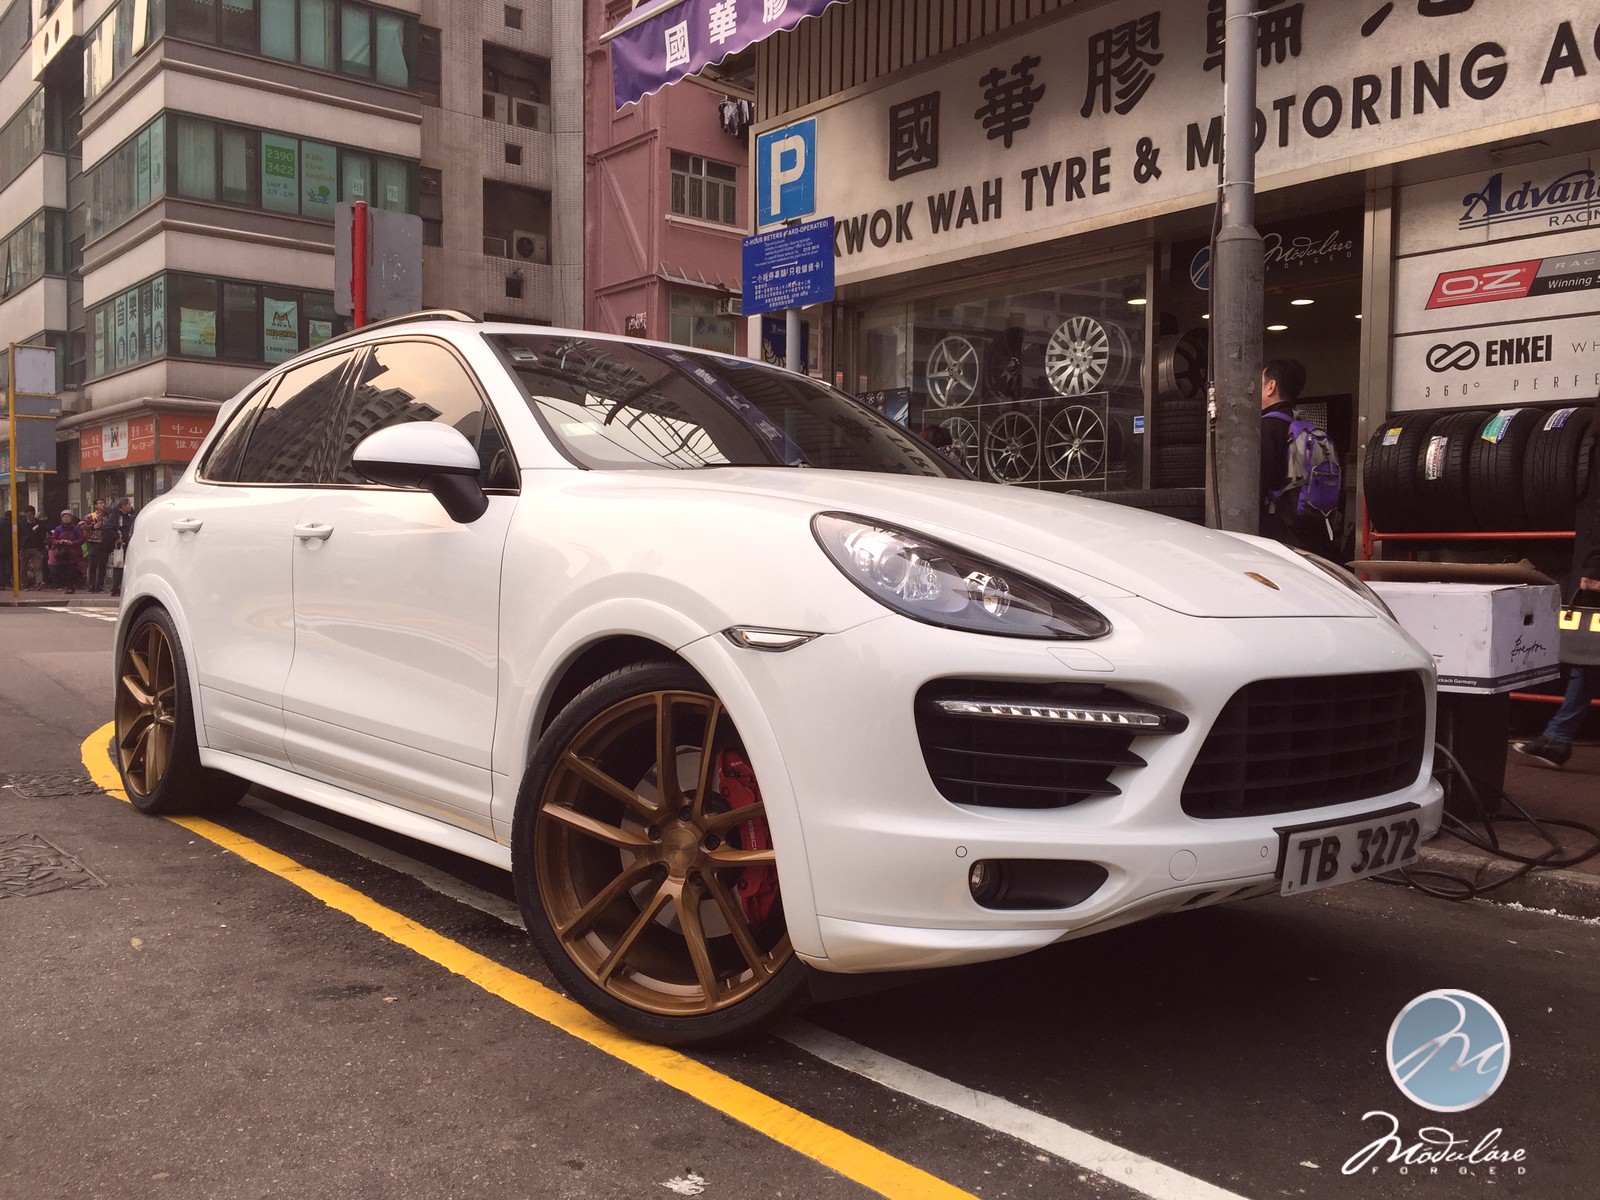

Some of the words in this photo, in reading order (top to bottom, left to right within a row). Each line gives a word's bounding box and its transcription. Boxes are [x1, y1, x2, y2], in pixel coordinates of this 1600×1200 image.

[927, 178, 1002, 234] WAH
[1021, 148, 1111, 211] TYRE
[1133, 137, 1162, 184] &
[1541, 20, 1600, 84] A
[267, 149, 293, 162] 2390
[267, 163, 293, 175] 3422
[771, 135, 805, 216] P
[1459, 169, 1600, 221] Advan
[1548, 277, 1592, 289] Winning
[1486, 335, 1552, 367] ENKEI
[1299, 835, 1341, 886] TB
[1351, 817, 1420, 873] 3272
